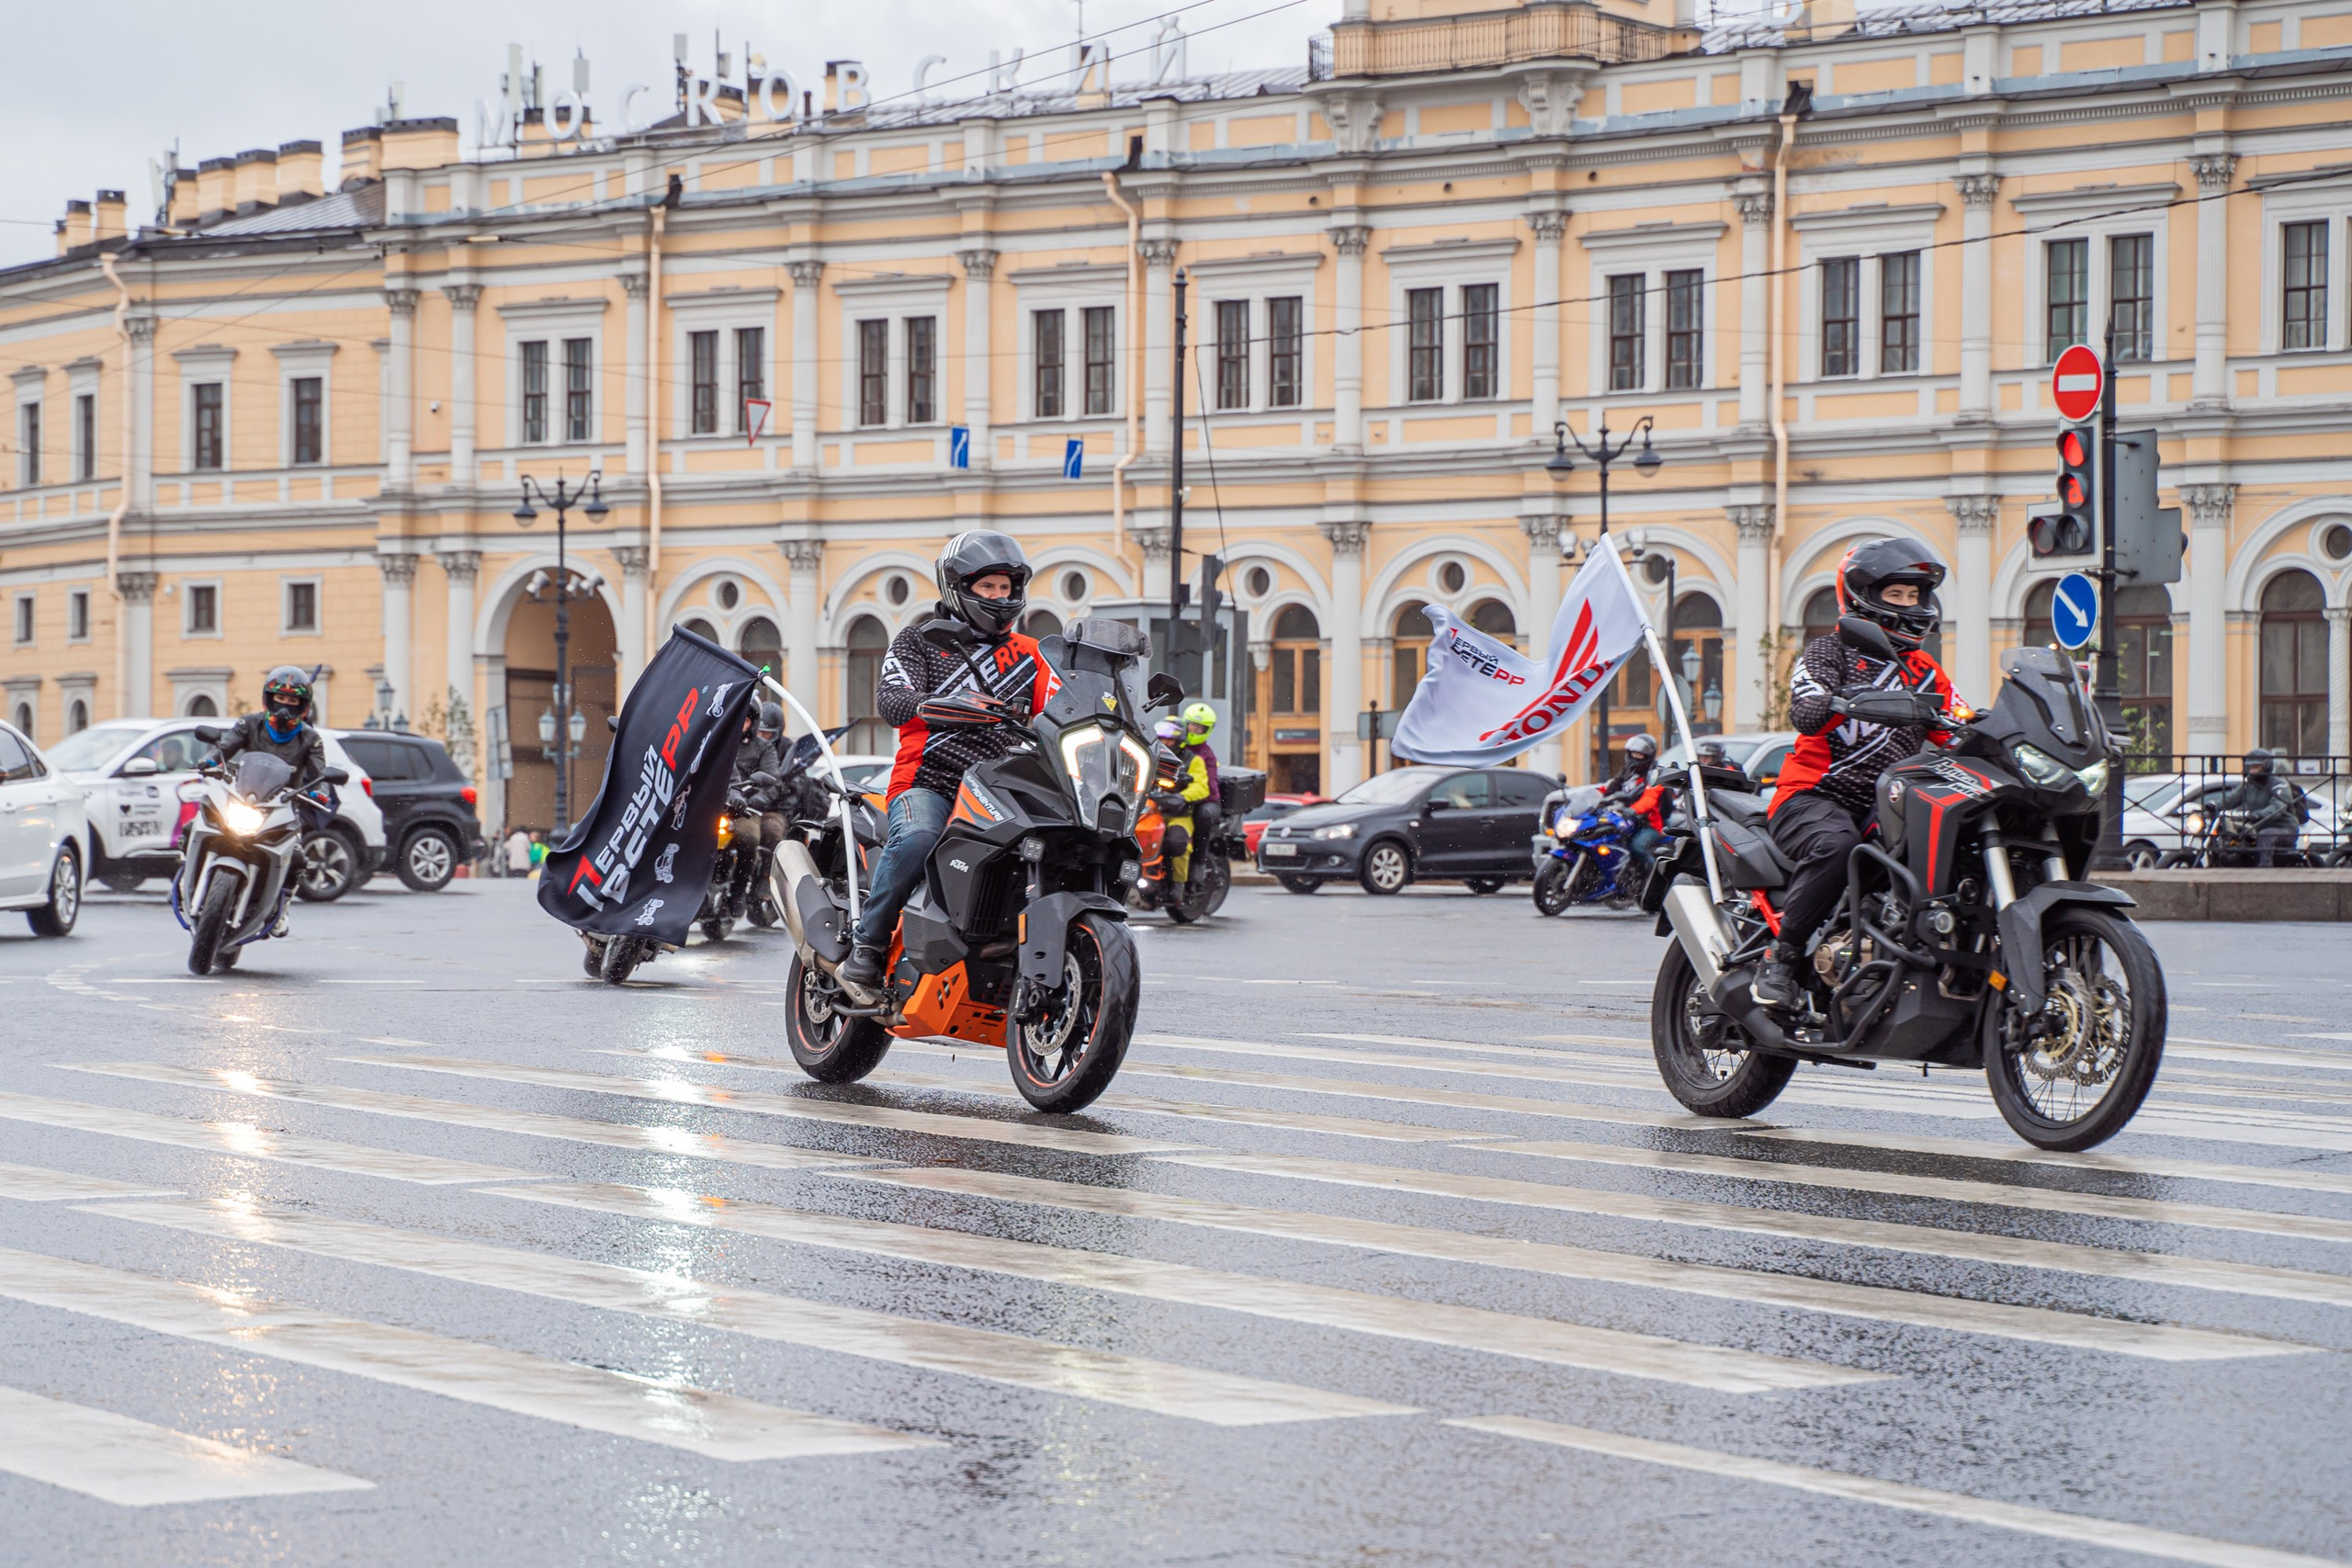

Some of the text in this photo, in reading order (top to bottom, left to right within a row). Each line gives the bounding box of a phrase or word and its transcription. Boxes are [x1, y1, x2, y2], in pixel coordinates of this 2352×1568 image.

[472, 17, 1188, 146] МОСКОВСКИЙ
[971, 788, 1004, 822] ADVENTURE
[949, 859, 969, 873] KTM
